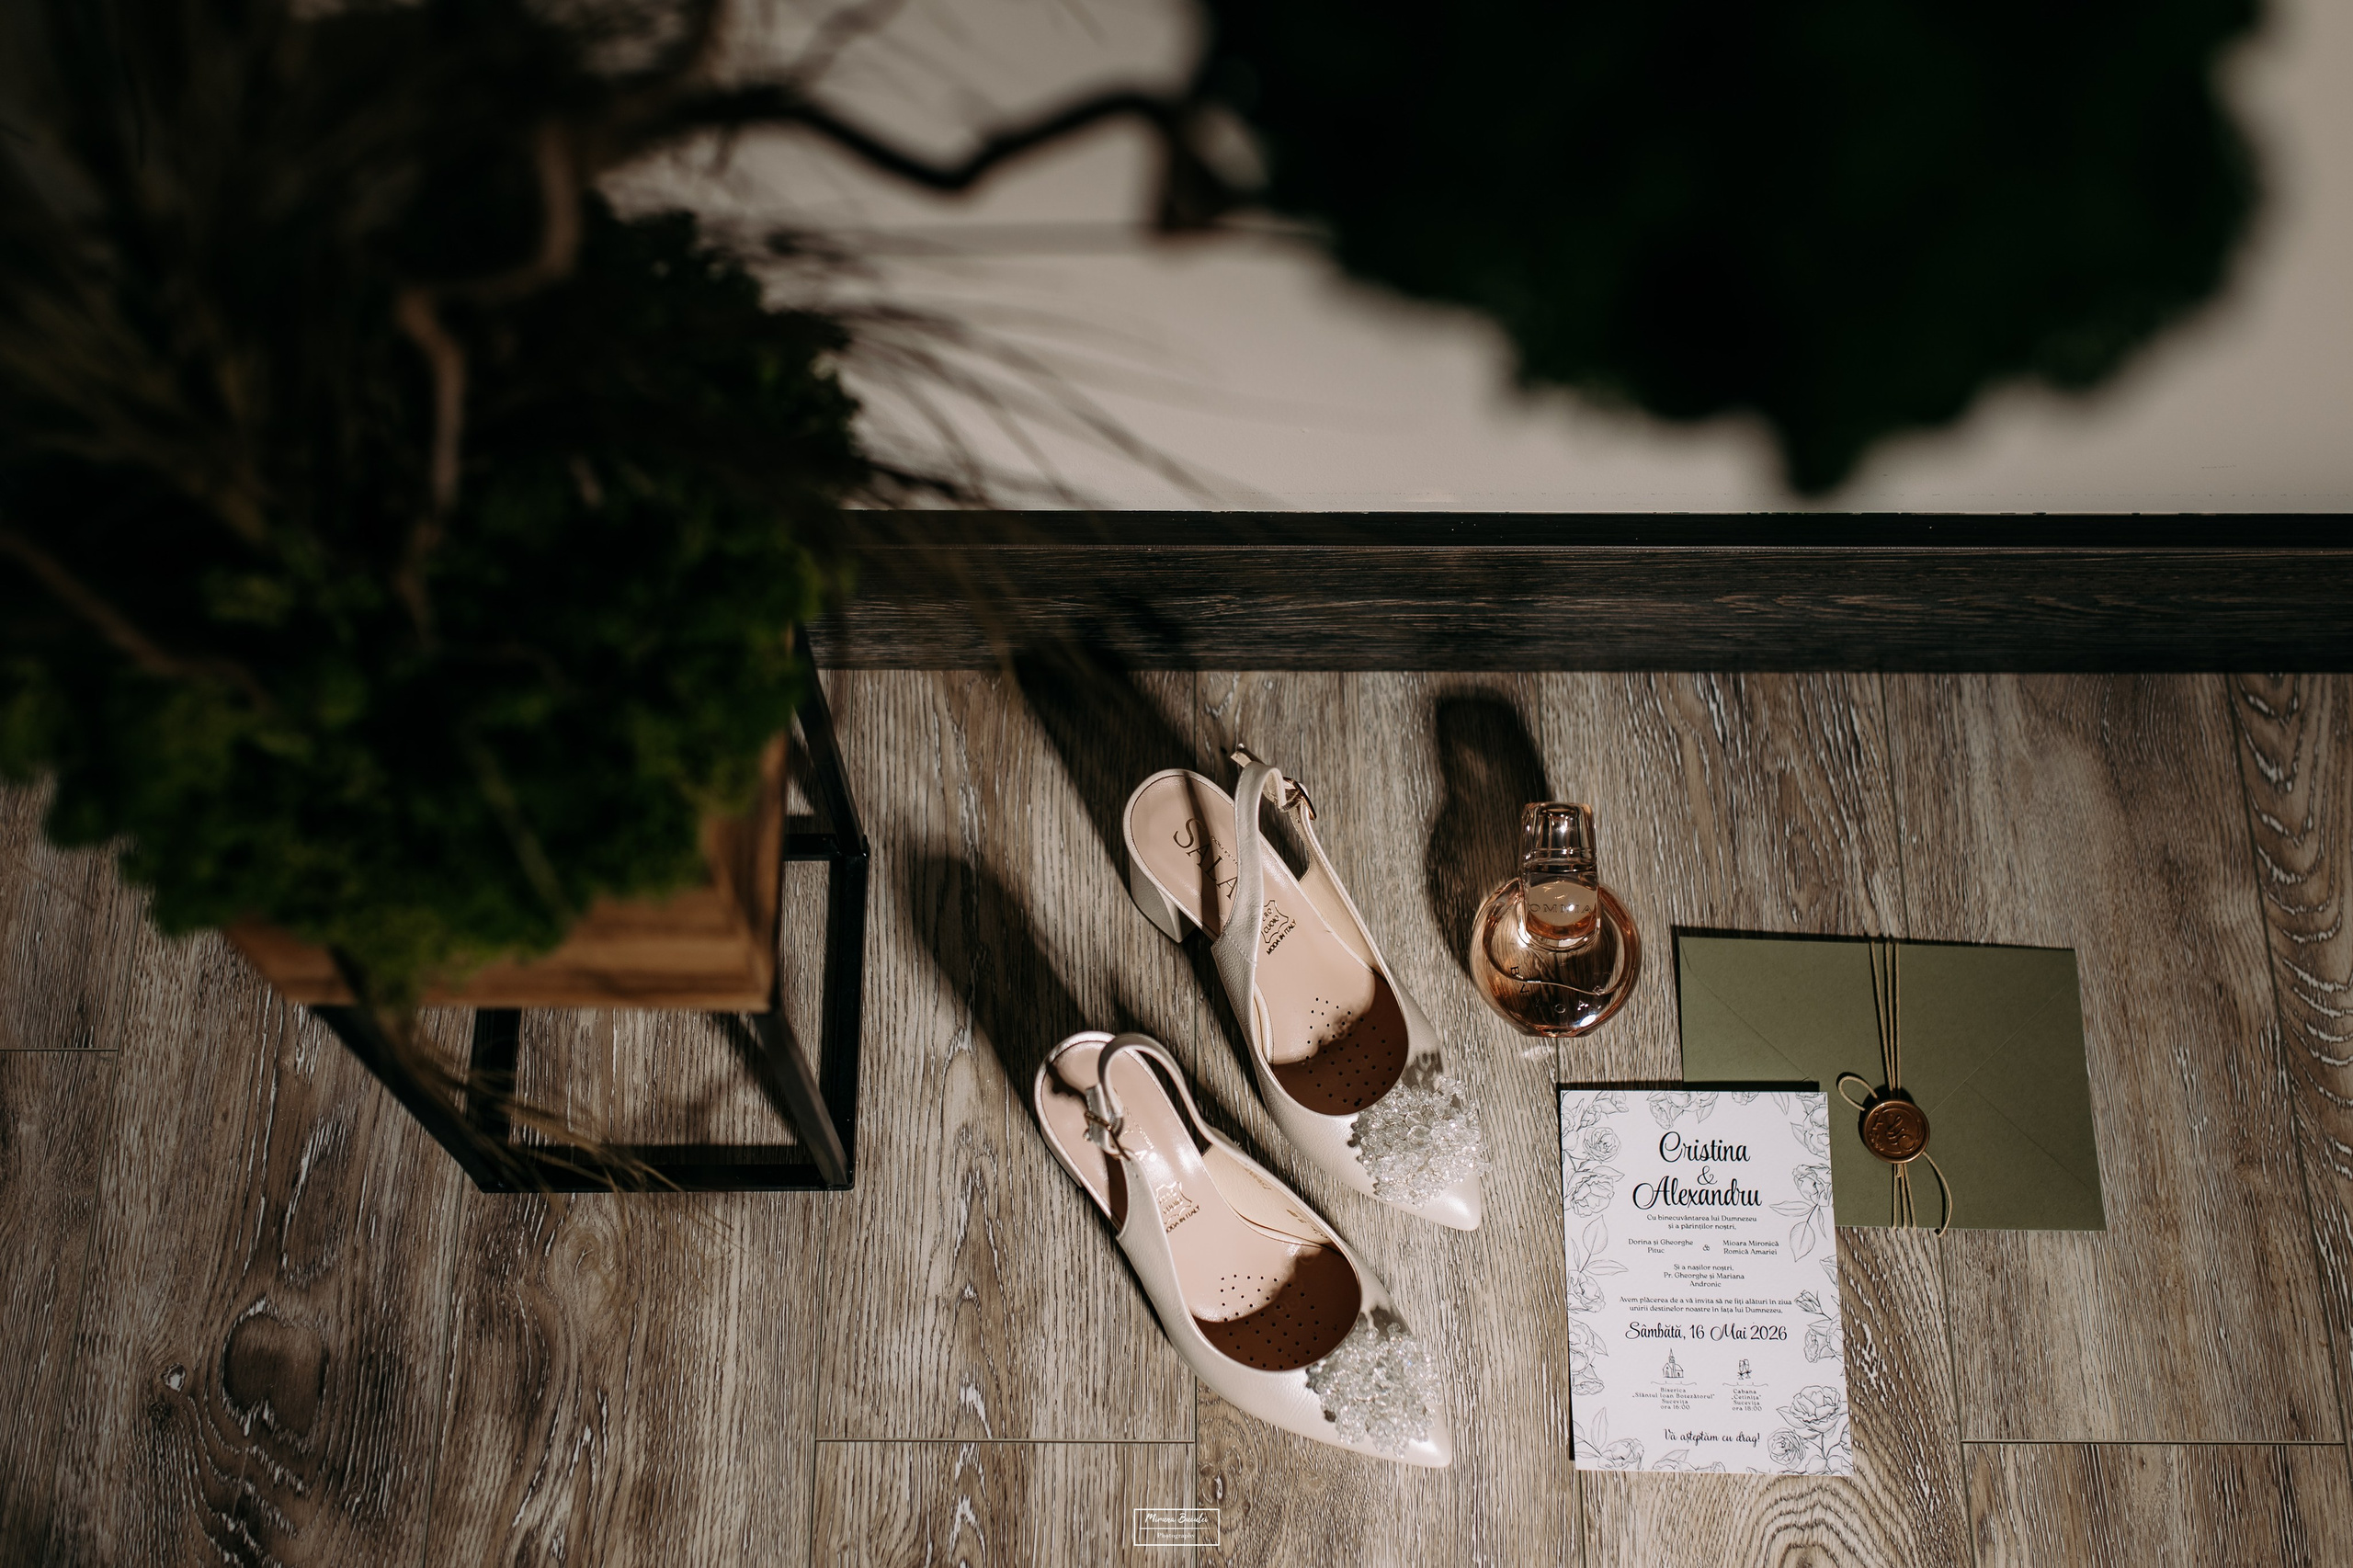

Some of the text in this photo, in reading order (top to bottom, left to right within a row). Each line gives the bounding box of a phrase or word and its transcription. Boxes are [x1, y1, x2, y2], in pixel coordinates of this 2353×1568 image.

[1173, 818, 1237, 900] SALA
[1284, 919, 1297, 935] ITALY
[1659, 1131, 1751, 1163] Cristina
[1697, 1165, 1718, 1186] &
[1632, 1176, 1763, 1210] Alexandru
[1660, 1238, 1694, 1246] Gheorghe
[1625, 1321, 1788, 1341] Sâmbătă, 16 Mai 2026
[1722, 1434, 1733, 1442] cu
[1735, 1430, 1760, 1448] drag!
